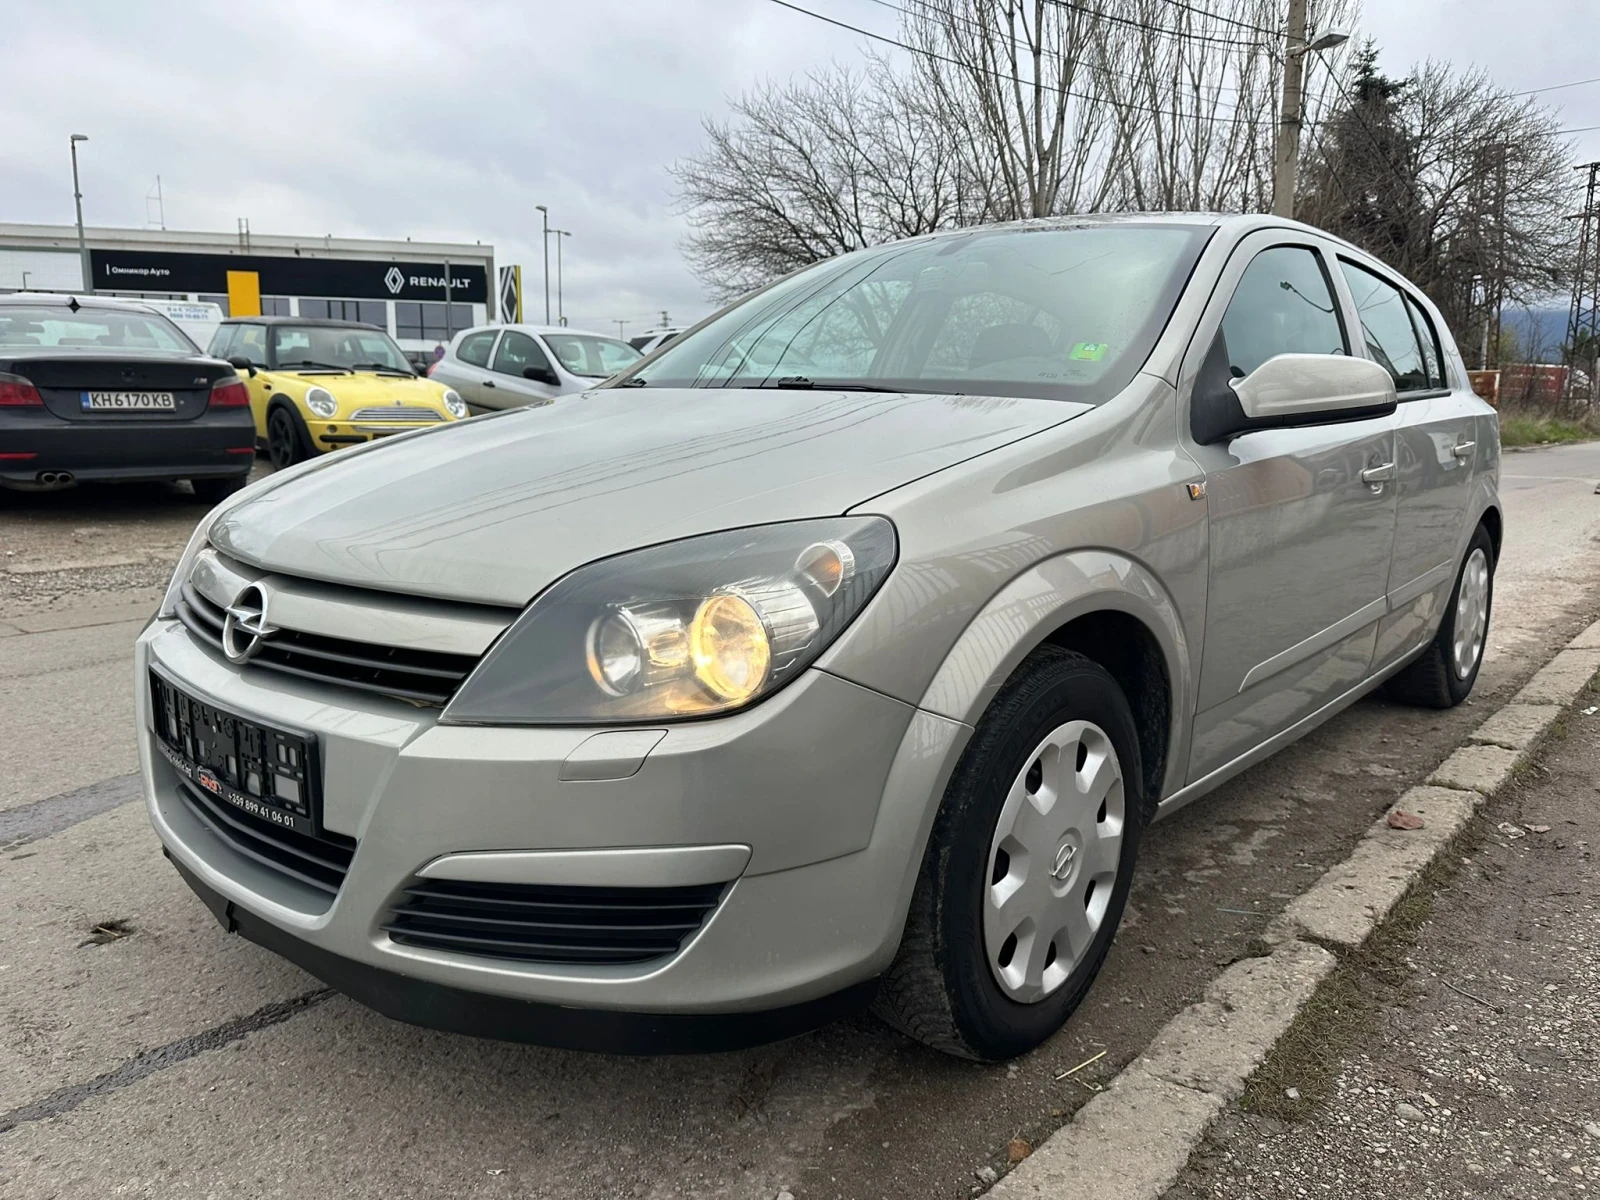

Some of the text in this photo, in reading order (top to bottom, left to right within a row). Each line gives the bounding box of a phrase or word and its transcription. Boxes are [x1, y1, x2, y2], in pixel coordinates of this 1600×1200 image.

[150, 267, 170, 277] Ауто
[245, 800, 259, 813] 899
[260, 806, 269, 818] 41
[272, 811, 283, 823] 06
[284, 815, 294, 828] 01
